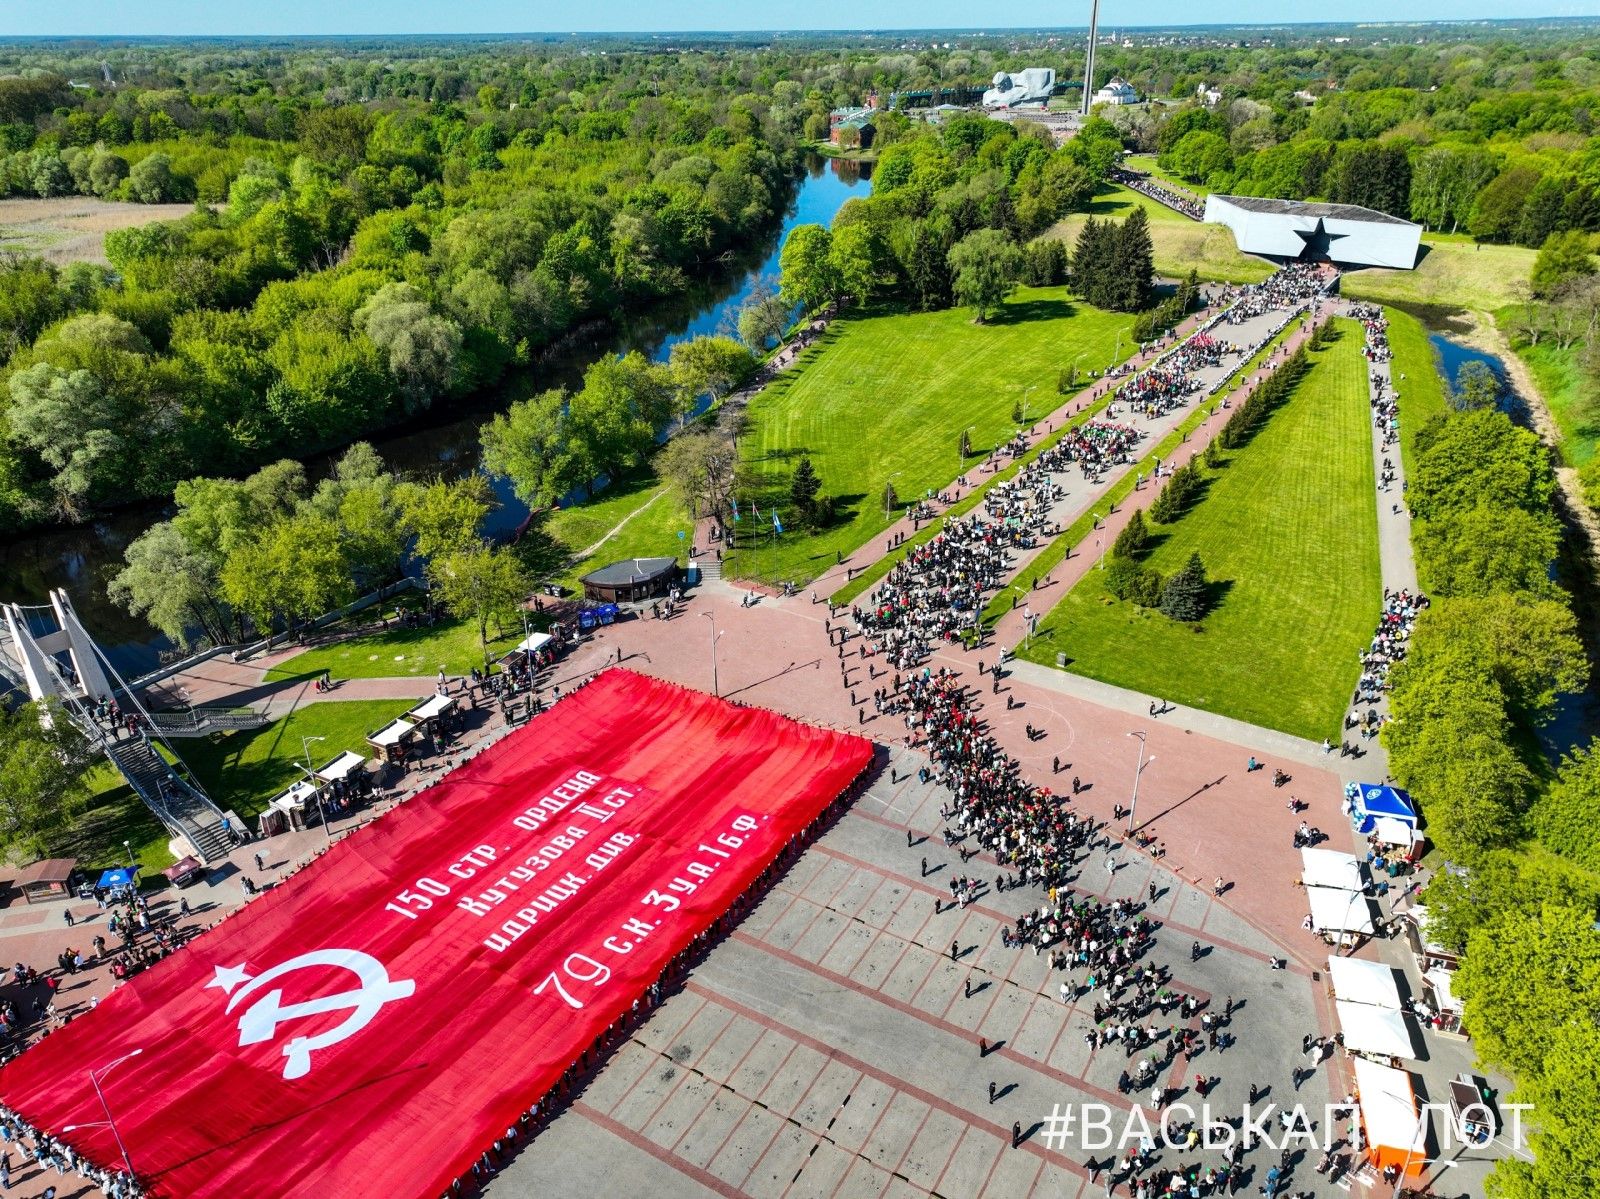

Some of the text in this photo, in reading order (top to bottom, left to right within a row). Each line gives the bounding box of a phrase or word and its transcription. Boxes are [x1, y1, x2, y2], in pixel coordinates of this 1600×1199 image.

[385, 770, 602, 920] 150 СТР. ОРДЕНА
[533, 952, 611, 1009] 79
